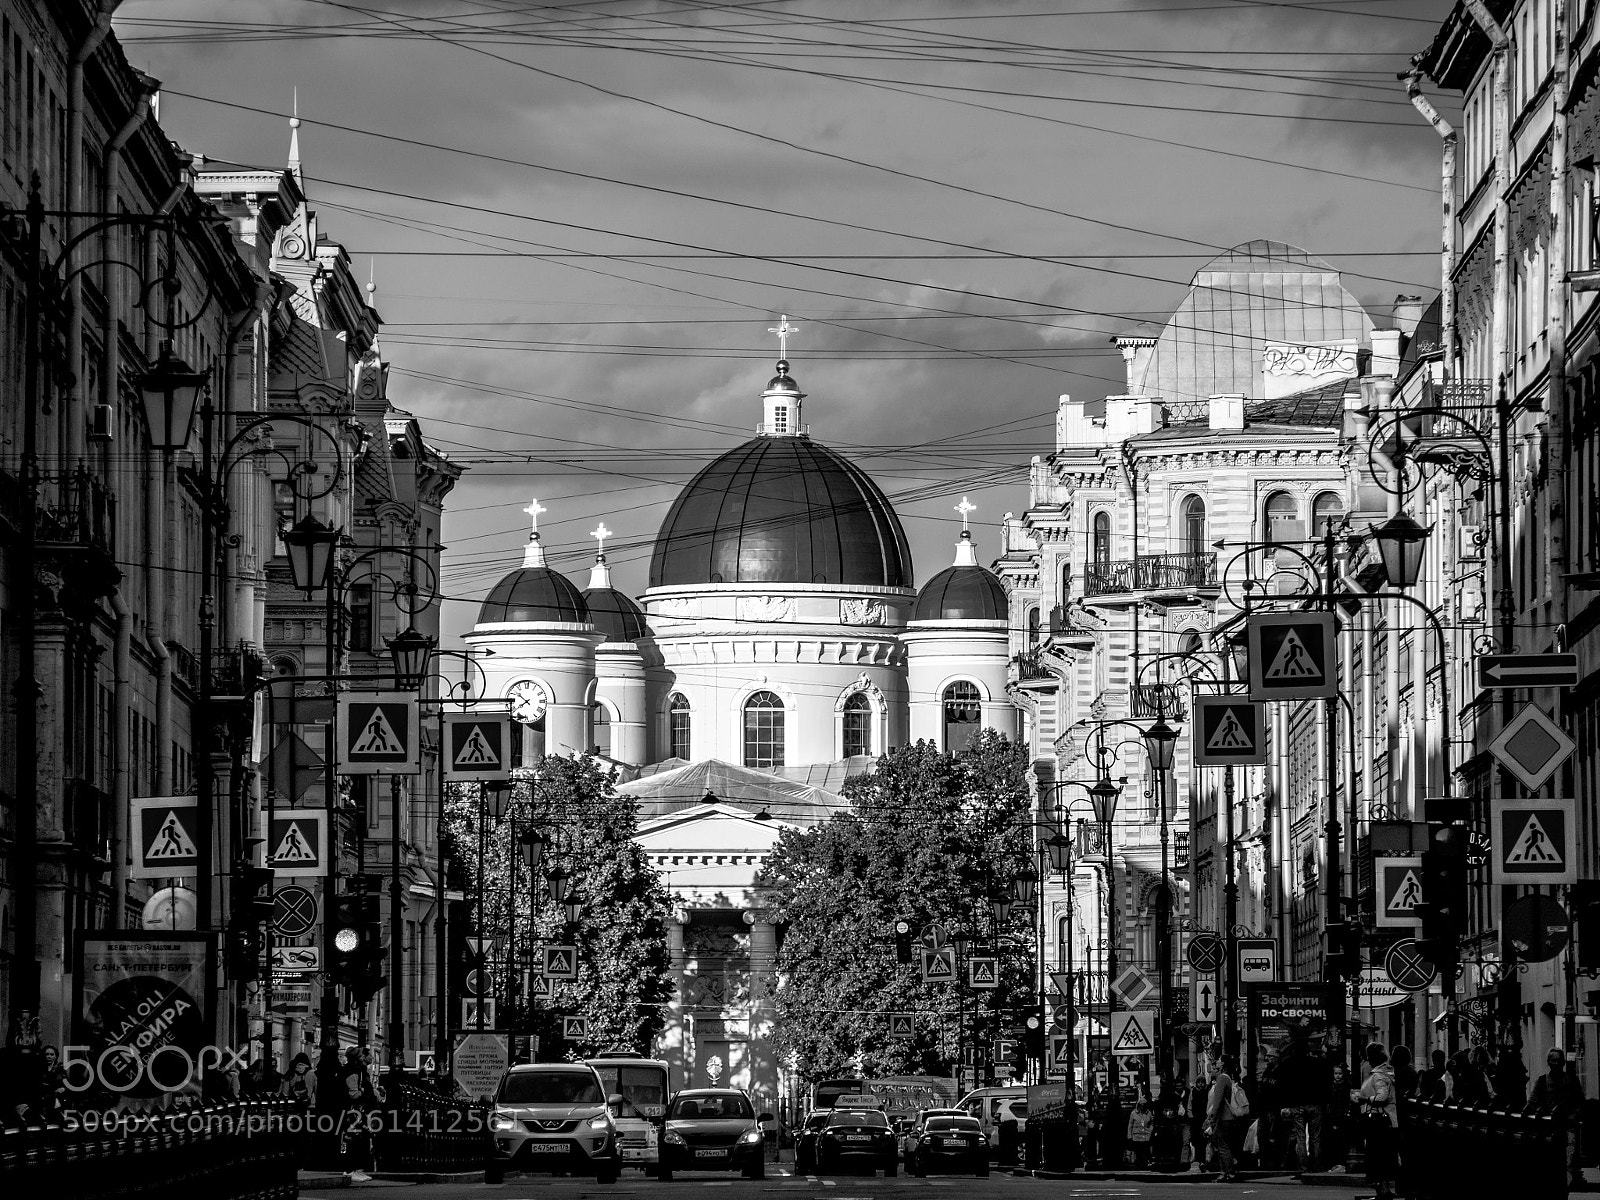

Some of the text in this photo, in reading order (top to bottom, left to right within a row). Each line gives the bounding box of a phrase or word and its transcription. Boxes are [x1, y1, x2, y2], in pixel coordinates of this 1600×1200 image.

[93, 963, 193, 972] САНКТ-ПЕТЕРБУРГ
[137, 989, 165, 1017] OLI
[1261, 994, 1319, 1008] Зафинти
[110, 999, 192, 1074] ЕМФИРА
